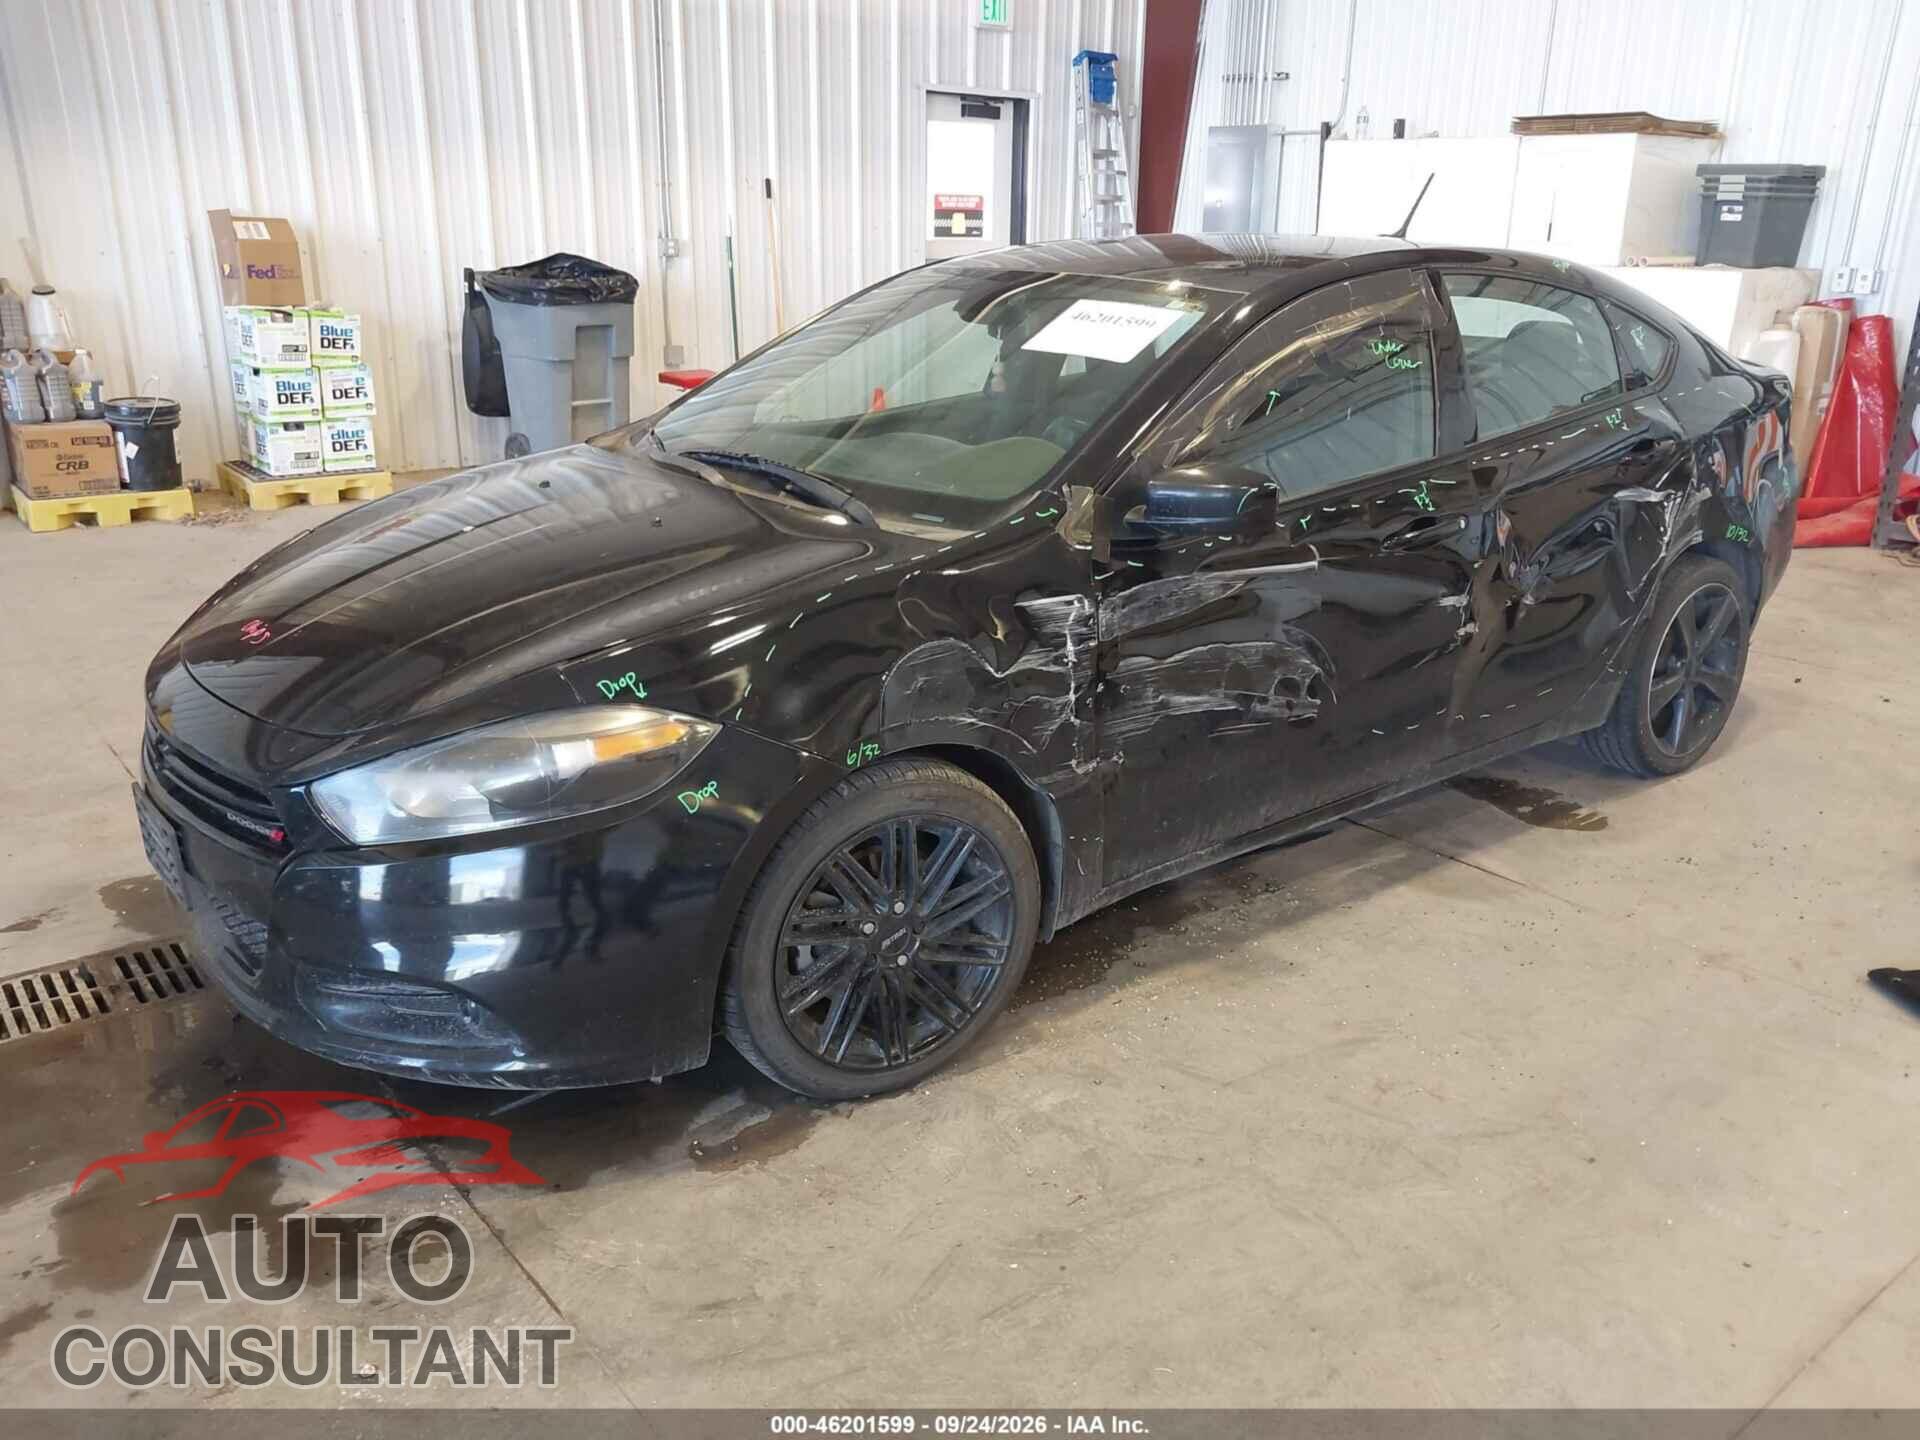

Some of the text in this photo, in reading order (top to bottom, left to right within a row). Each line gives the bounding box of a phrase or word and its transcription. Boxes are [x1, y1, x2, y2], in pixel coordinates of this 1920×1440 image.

[319, 324, 353, 338] Blue
[319, 337, 353, 350] DEF
[275, 380, 312, 393] Blue
[332, 386, 365, 401] DEF
[276, 391, 312, 405] DEF
[331, 439, 365, 453] DEF
[55, 459, 90, 472] CRB
[595, 671, 640, 700] Drop
[846, 741, 881, 768] 6/32
[677, 780, 720, 814] Drop
